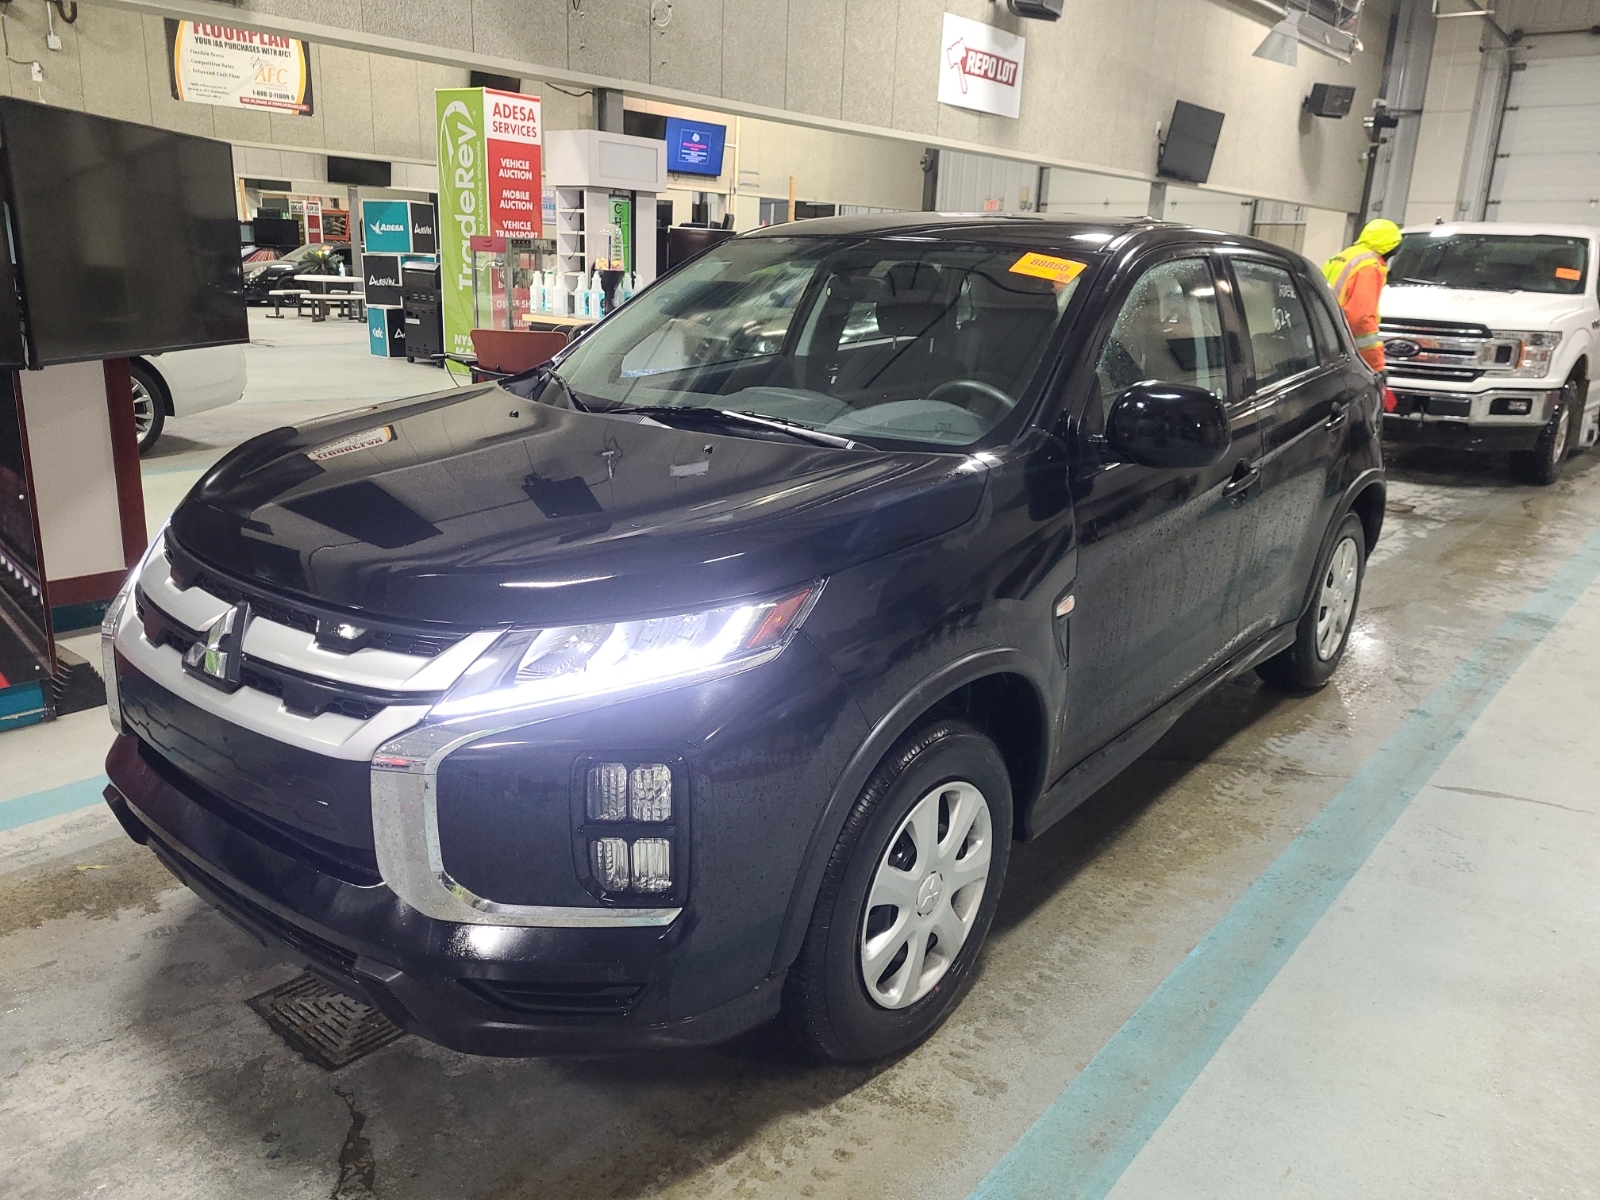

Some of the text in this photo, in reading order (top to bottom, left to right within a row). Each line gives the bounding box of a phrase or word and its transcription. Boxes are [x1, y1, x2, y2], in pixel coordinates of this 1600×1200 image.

[193, 21, 290, 49] FLOORPLAN
[194, 36, 212, 46] YOUR
[224, 42, 261, 53] PURCHASES
[261, 47, 278, 55] WITH
[965, 50, 1017, 84] REPO LOT
[254, 66, 288, 85] AFC
[492, 102, 537, 124] ADESA
[492, 120, 538, 138] SERVICES
[500, 157, 531, 171] VEHICLE
[498, 168, 534, 181] AUCTION
[502, 188, 531, 201] MOBILE
[454, 121, 477, 291] TradeRev
[498, 199, 534, 211] AUCTION
[501, 219, 533, 231] VEHICLE
[494, 229, 540, 239] TRANSPORT
[1030, 258, 1071, 272] 88850
